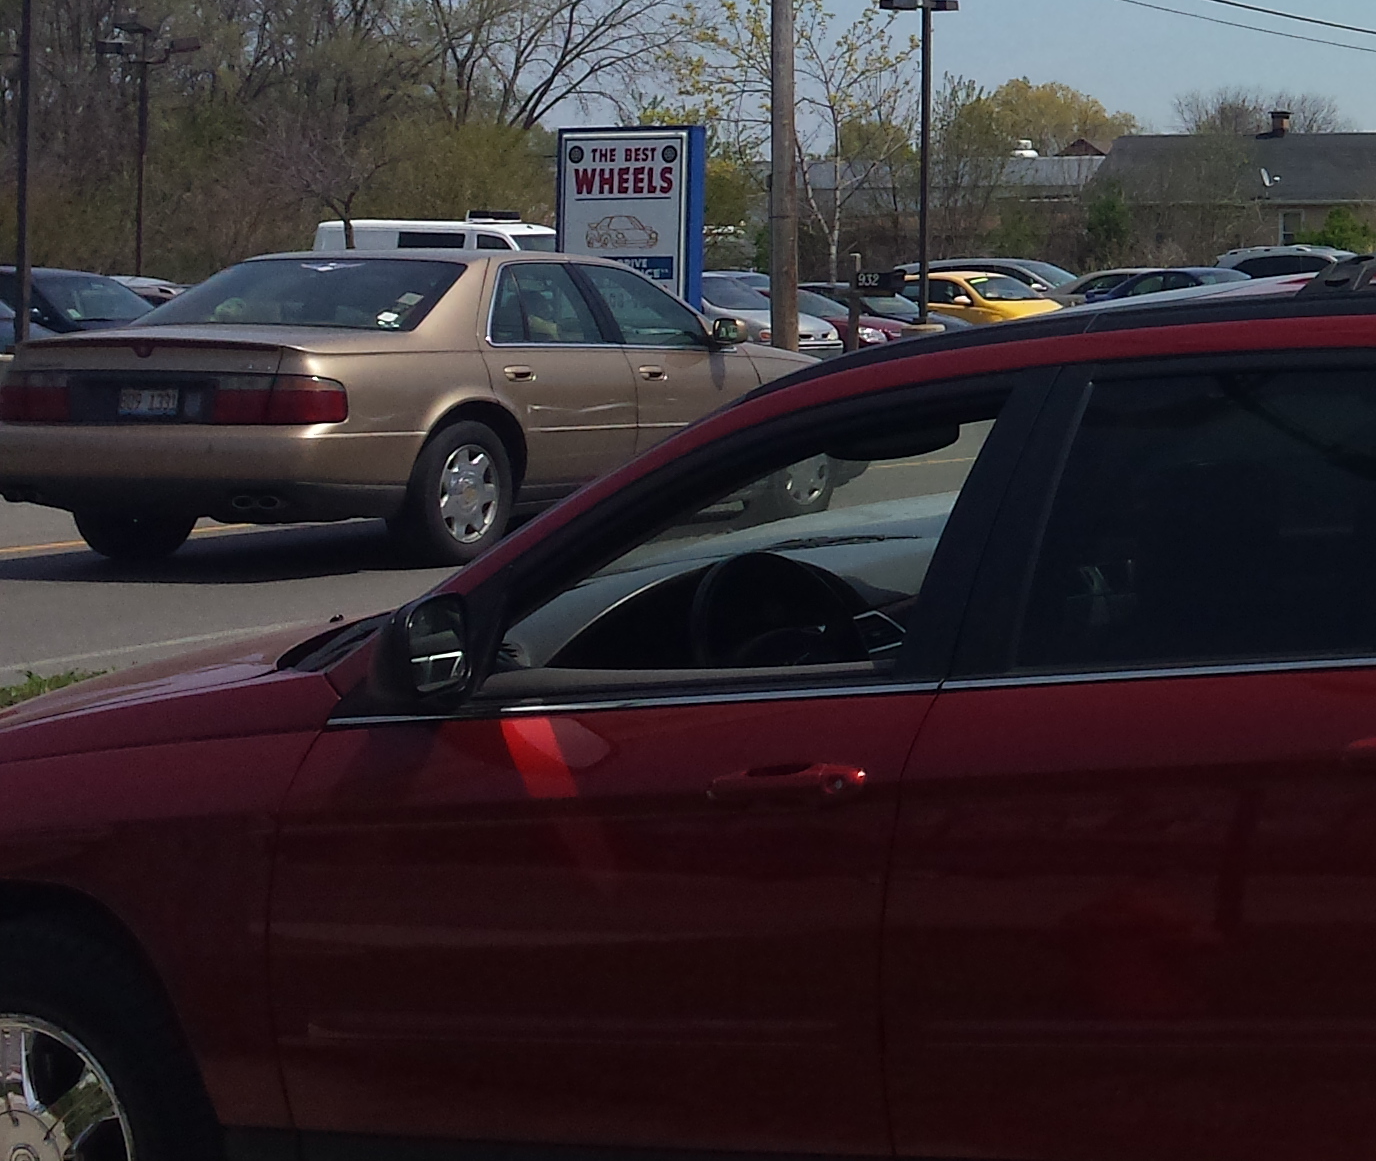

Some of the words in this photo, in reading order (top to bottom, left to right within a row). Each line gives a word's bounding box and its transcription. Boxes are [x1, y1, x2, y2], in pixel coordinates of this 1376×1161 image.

[591, 147, 617, 163] THE
[624, 147, 657, 163] BEST
[574, 166, 674, 195] WHEELS
[858, 273, 879, 286] 932
